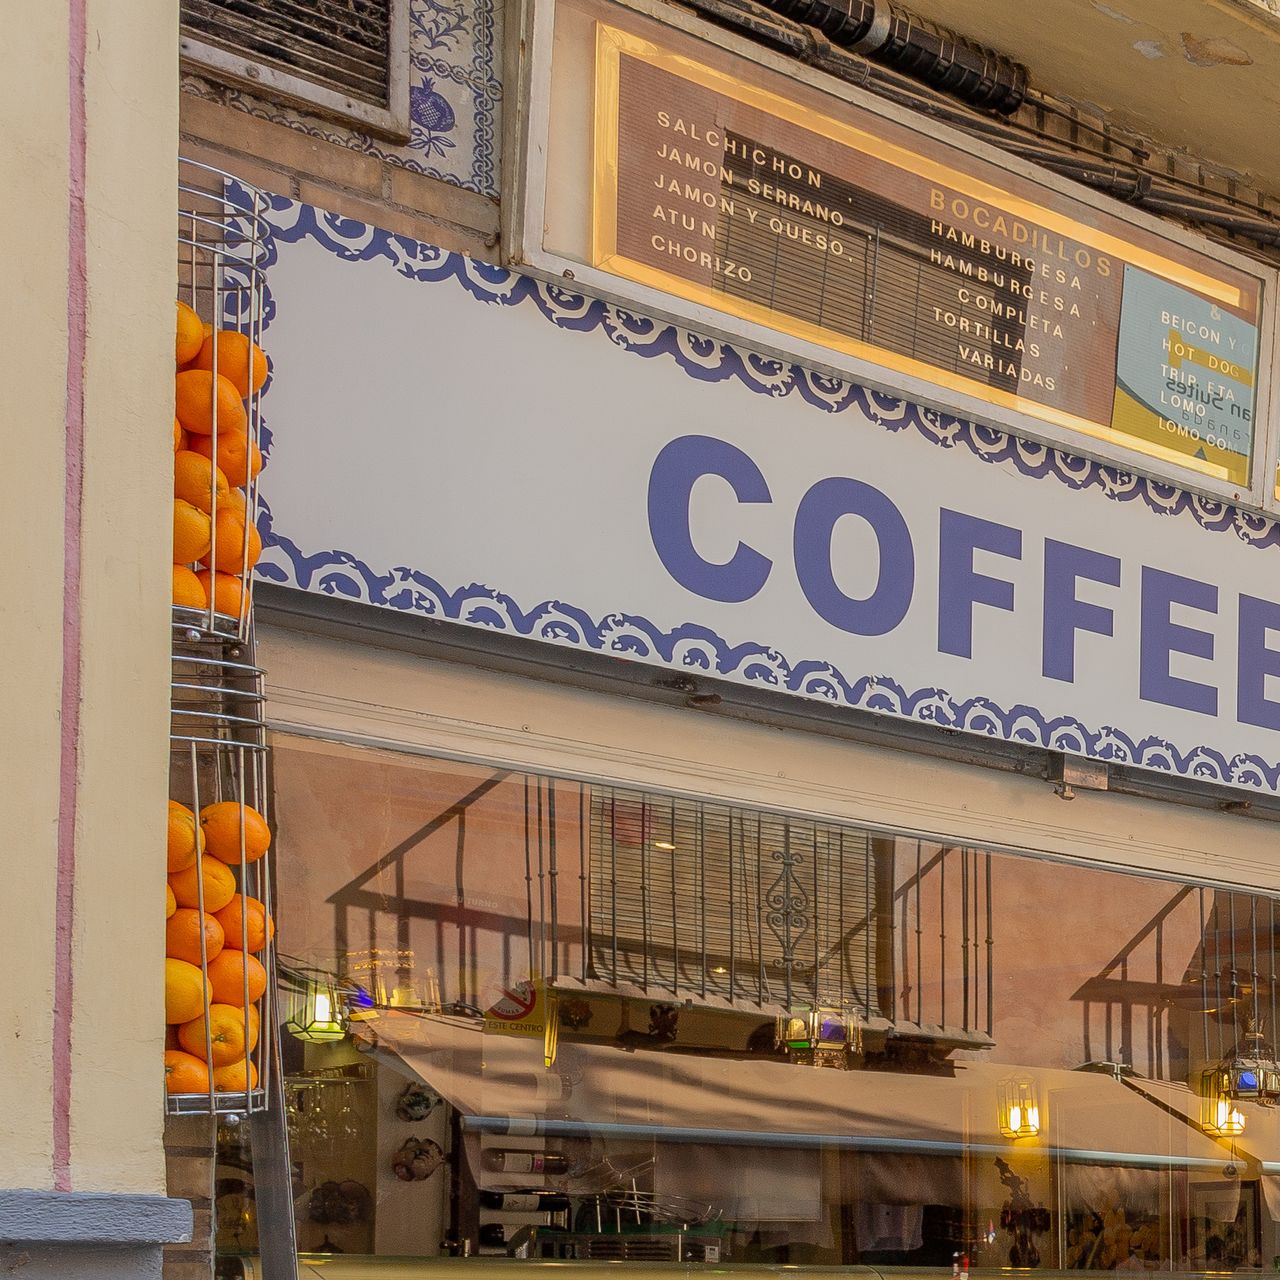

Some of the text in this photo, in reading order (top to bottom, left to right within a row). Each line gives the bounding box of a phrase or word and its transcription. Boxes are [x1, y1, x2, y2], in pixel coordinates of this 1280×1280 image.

[657, 111, 823, 189] SALCHICHON
[656, 144, 845, 226] JAMON SERRANO
[653, 206, 716, 239] ATUN
[655, 175, 844, 256] JAMON Y QUESO
[930, 190, 1112, 277] BOCADILLOS
[651, 236, 752, 283] CHORIZO
[930, 221, 1082, 290] HAMBURGESA
[930, 249, 1080, 319] HAMBURGESA
[933, 307, 1040, 358] TORTILLAS
[958, 288, 1063, 339] COMPLETA
[1162, 312, 1220, 344] BEICON
[1210, 304, 1221, 320] &
[958, 347, 1055, 391] VARIADAS
[1162, 339, 1239, 377] HOT DOG
[1160, 390, 1206, 416] LOMO
[1159, 417, 1200, 442] LOMO
[489, 1021, 543, 1032] ESTE CENTRO
